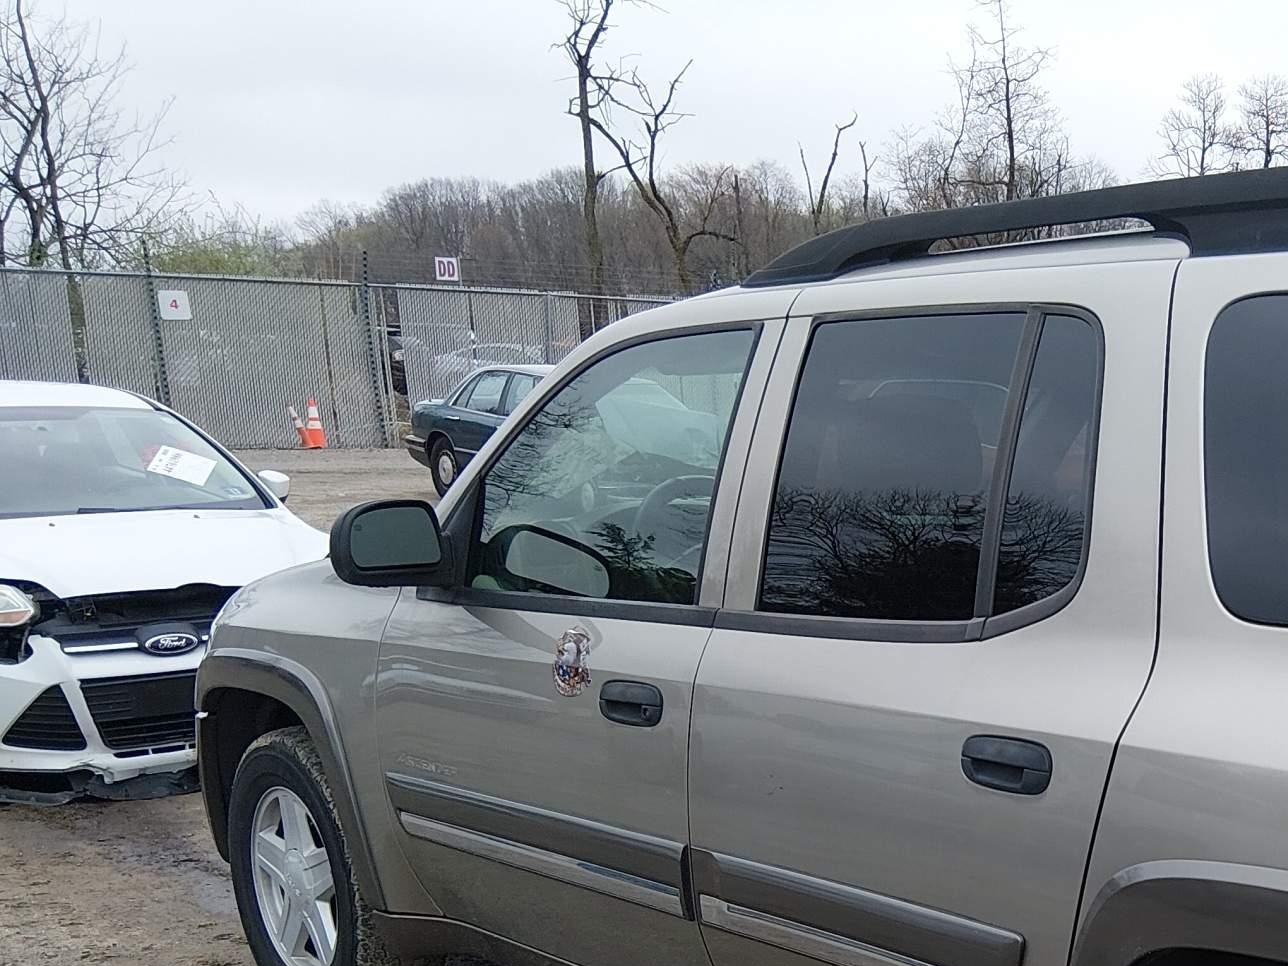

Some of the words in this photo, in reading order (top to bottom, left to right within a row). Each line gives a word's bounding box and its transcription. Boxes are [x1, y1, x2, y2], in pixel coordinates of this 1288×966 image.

[437, 260, 456, 278] DD
[169, 298, 179, 310] 4
[158, 636, 187, 650] Ford
